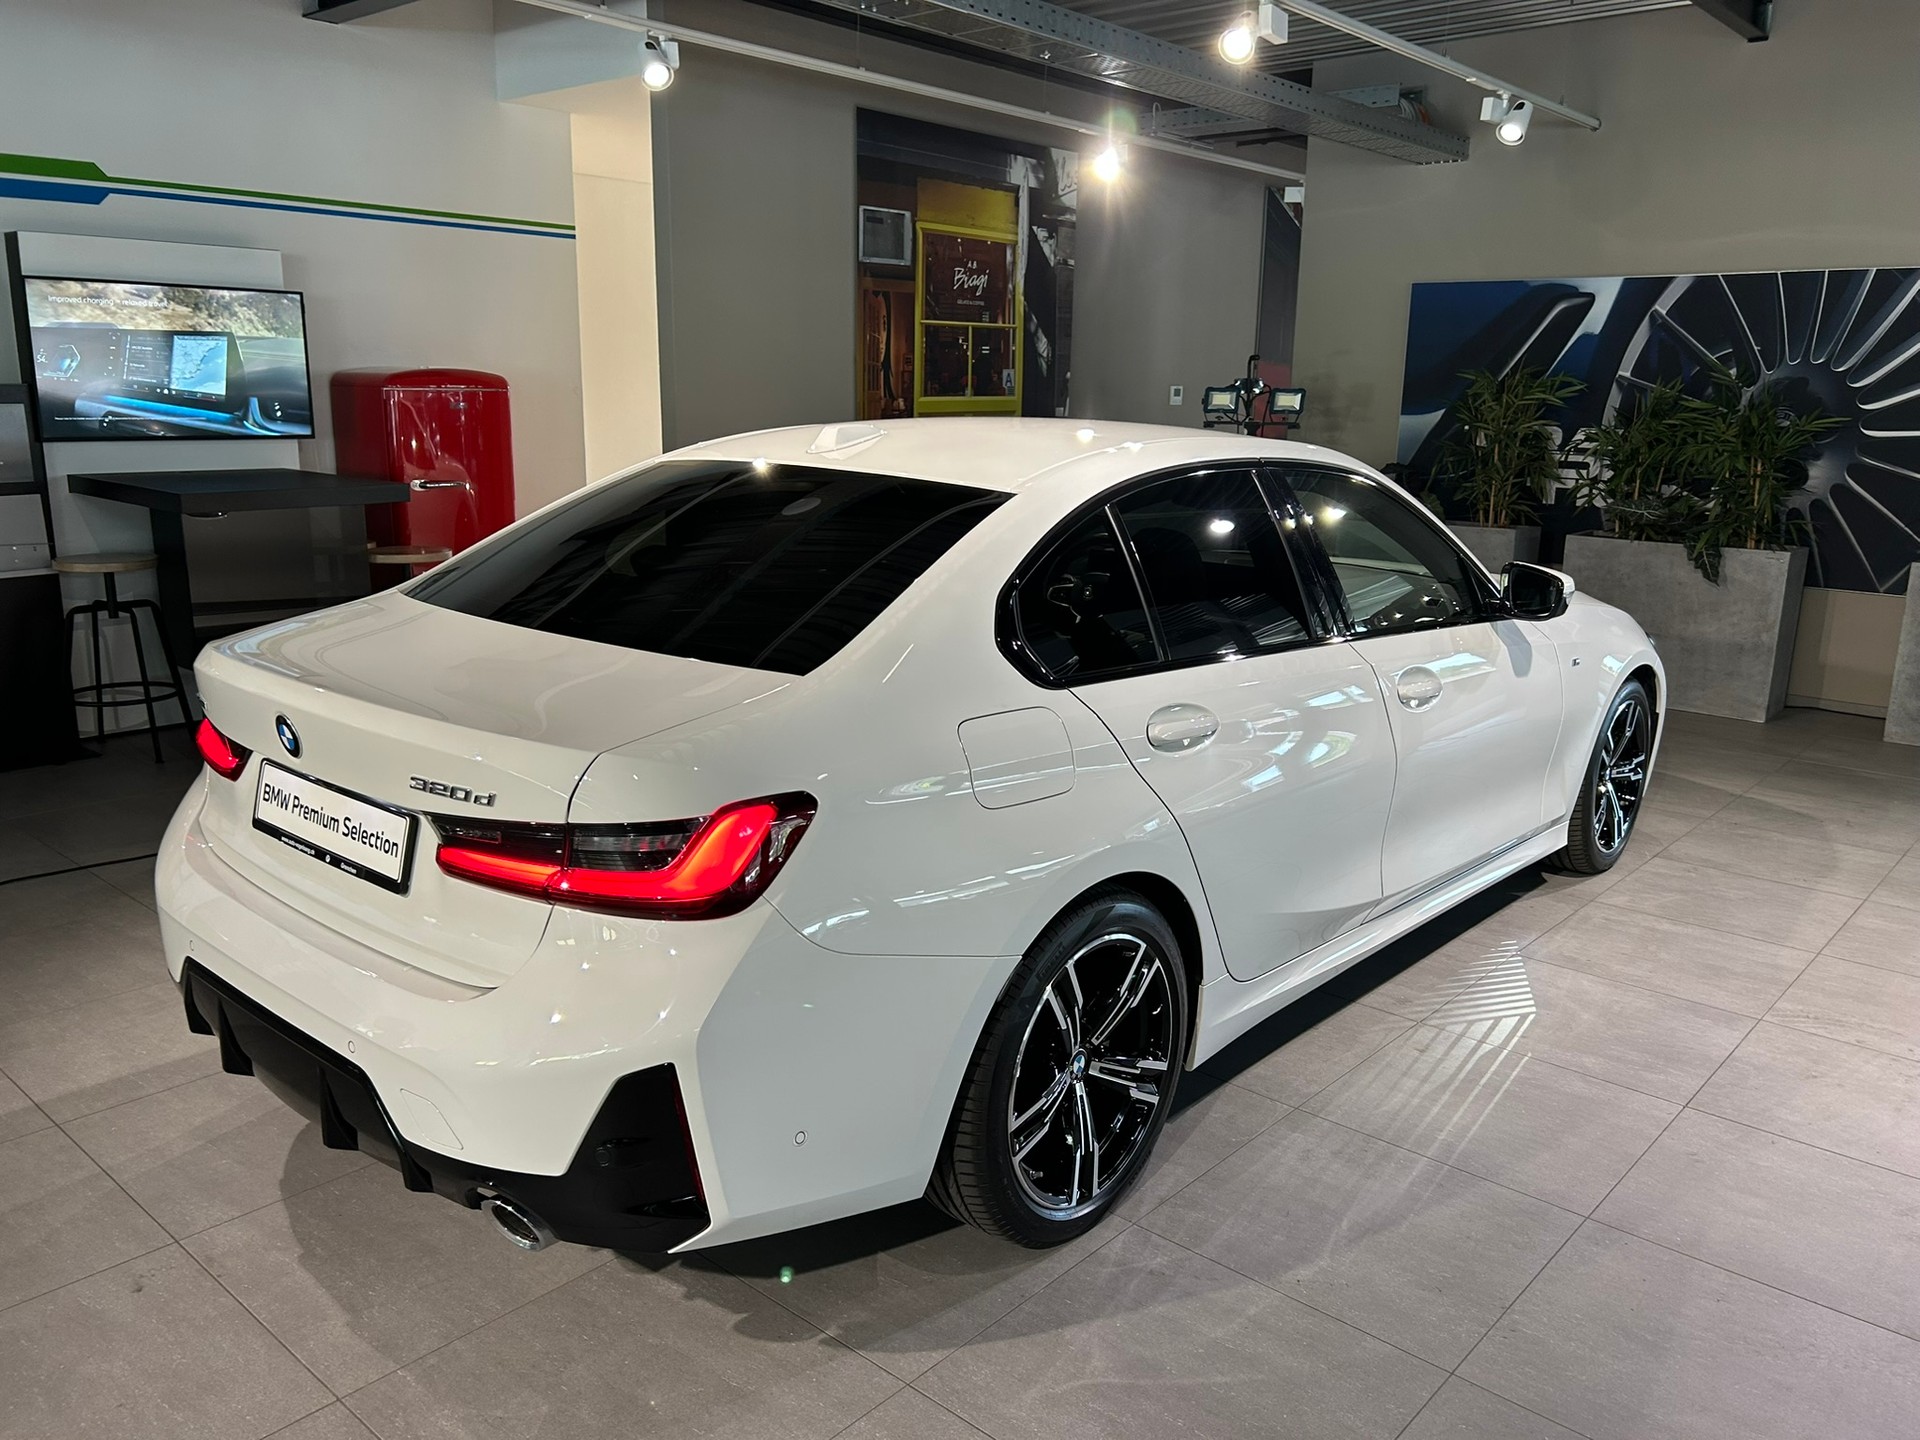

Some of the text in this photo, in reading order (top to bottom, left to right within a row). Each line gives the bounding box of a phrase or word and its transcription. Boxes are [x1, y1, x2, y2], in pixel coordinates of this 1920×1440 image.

[953, 267, 989, 296] Biagi
[48, 295, 82, 304] Improved
[83, 296, 114, 306] charging
[122, 298, 148, 307] relaxed
[262, 782, 399, 858] BMW Premium Selection
